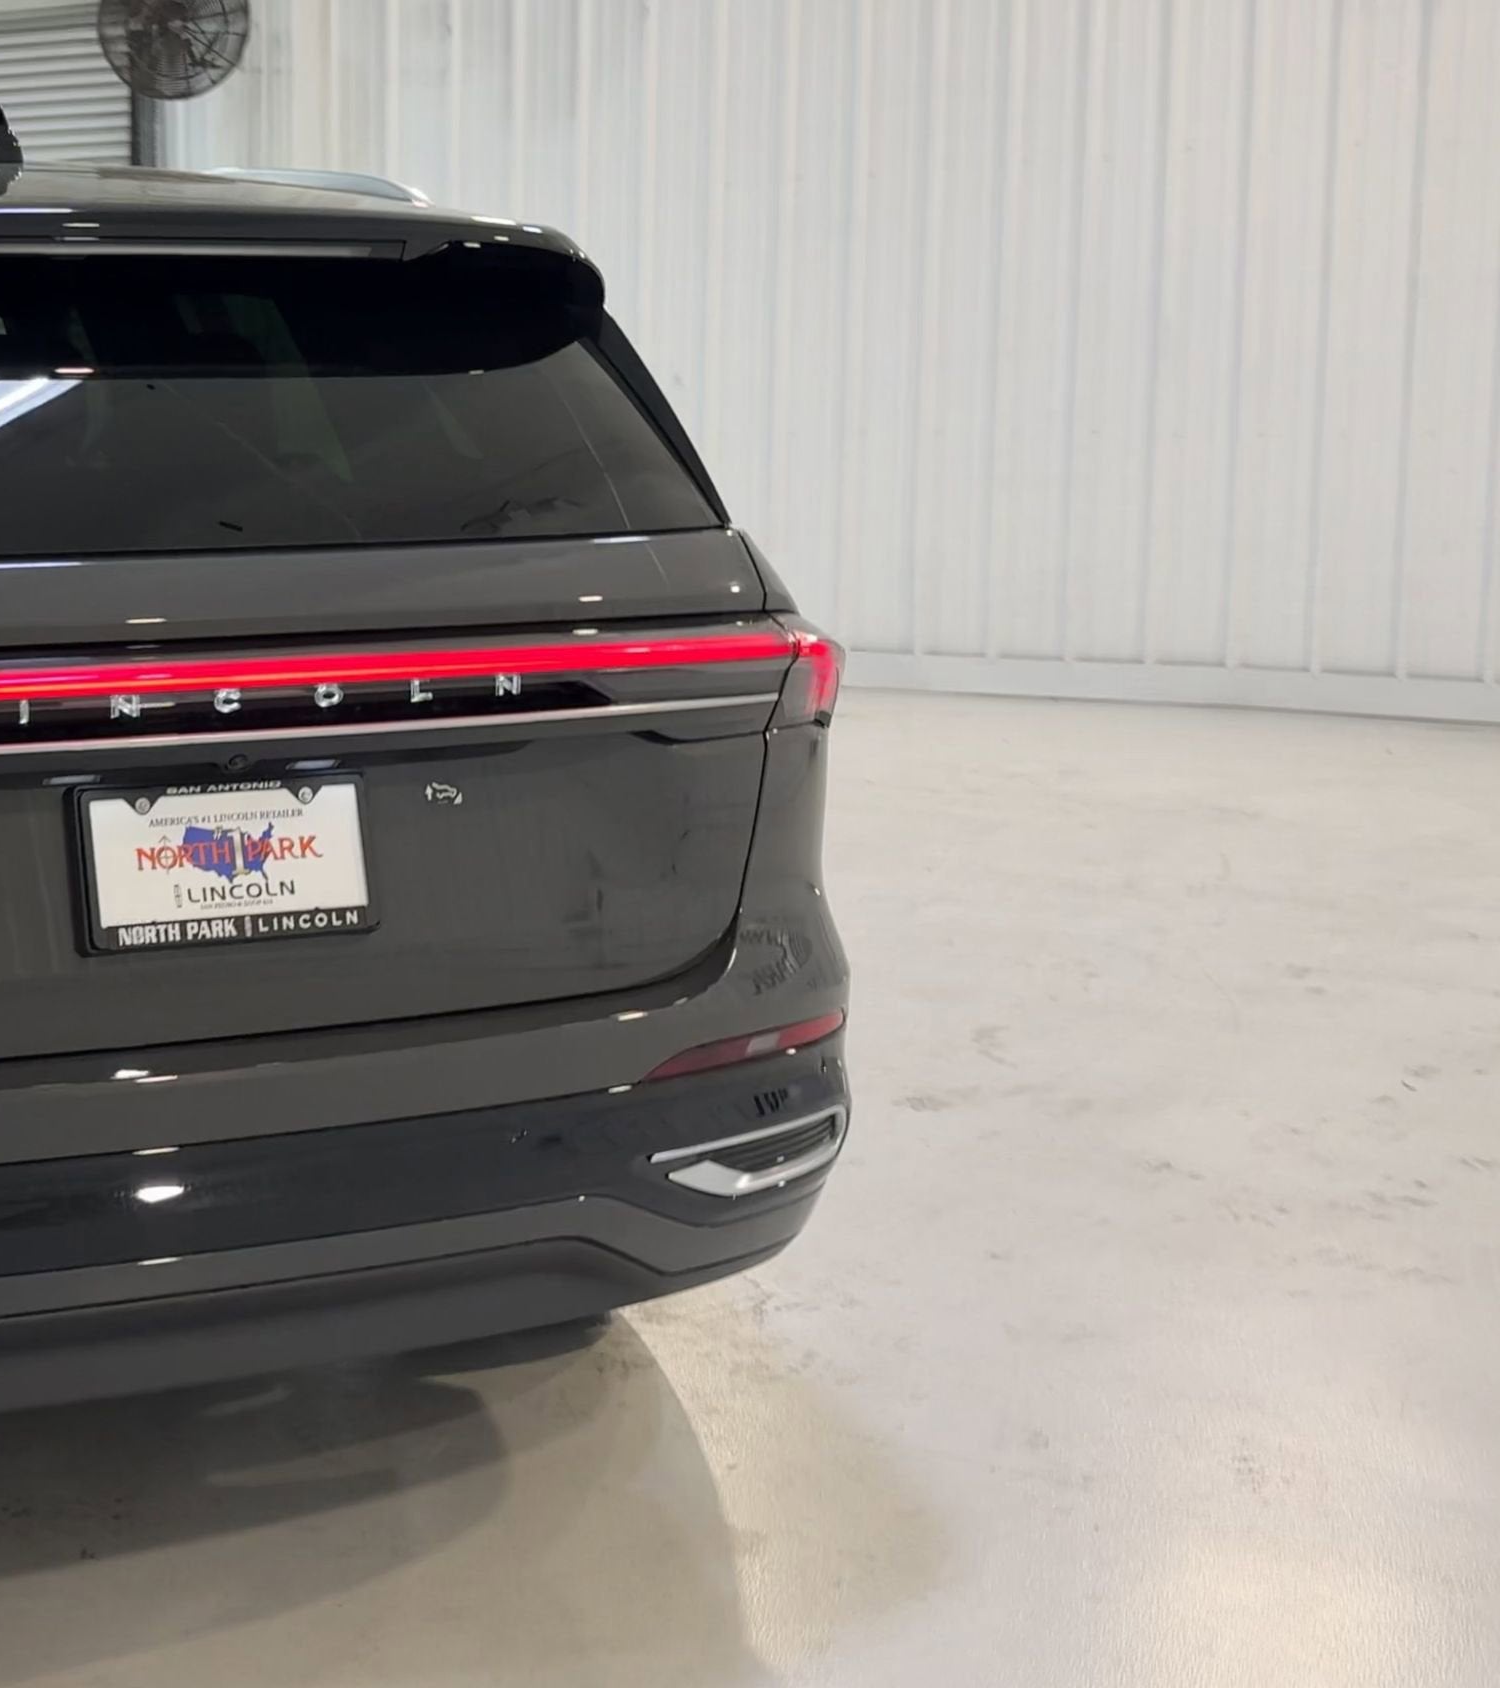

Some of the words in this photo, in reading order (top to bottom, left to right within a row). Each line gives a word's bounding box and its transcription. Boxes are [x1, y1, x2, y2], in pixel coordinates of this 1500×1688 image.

[165, 785, 202, 795] SAN
[206, 780, 282, 793] ANTONIO
[148, 814, 200, 828] AMERICA'S
[214, 810, 257, 824] LINCOLN
[259, 807, 303, 820] RETAILER
[135, 838, 231, 871] NORTH
[245, 834, 324, 862] PARK
[187, 879, 295, 903] LINCOLN
[118, 925, 182, 946] NORTH
[186, 917, 238, 941] PARK
[258, 909, 360, 933] LINCOLN
